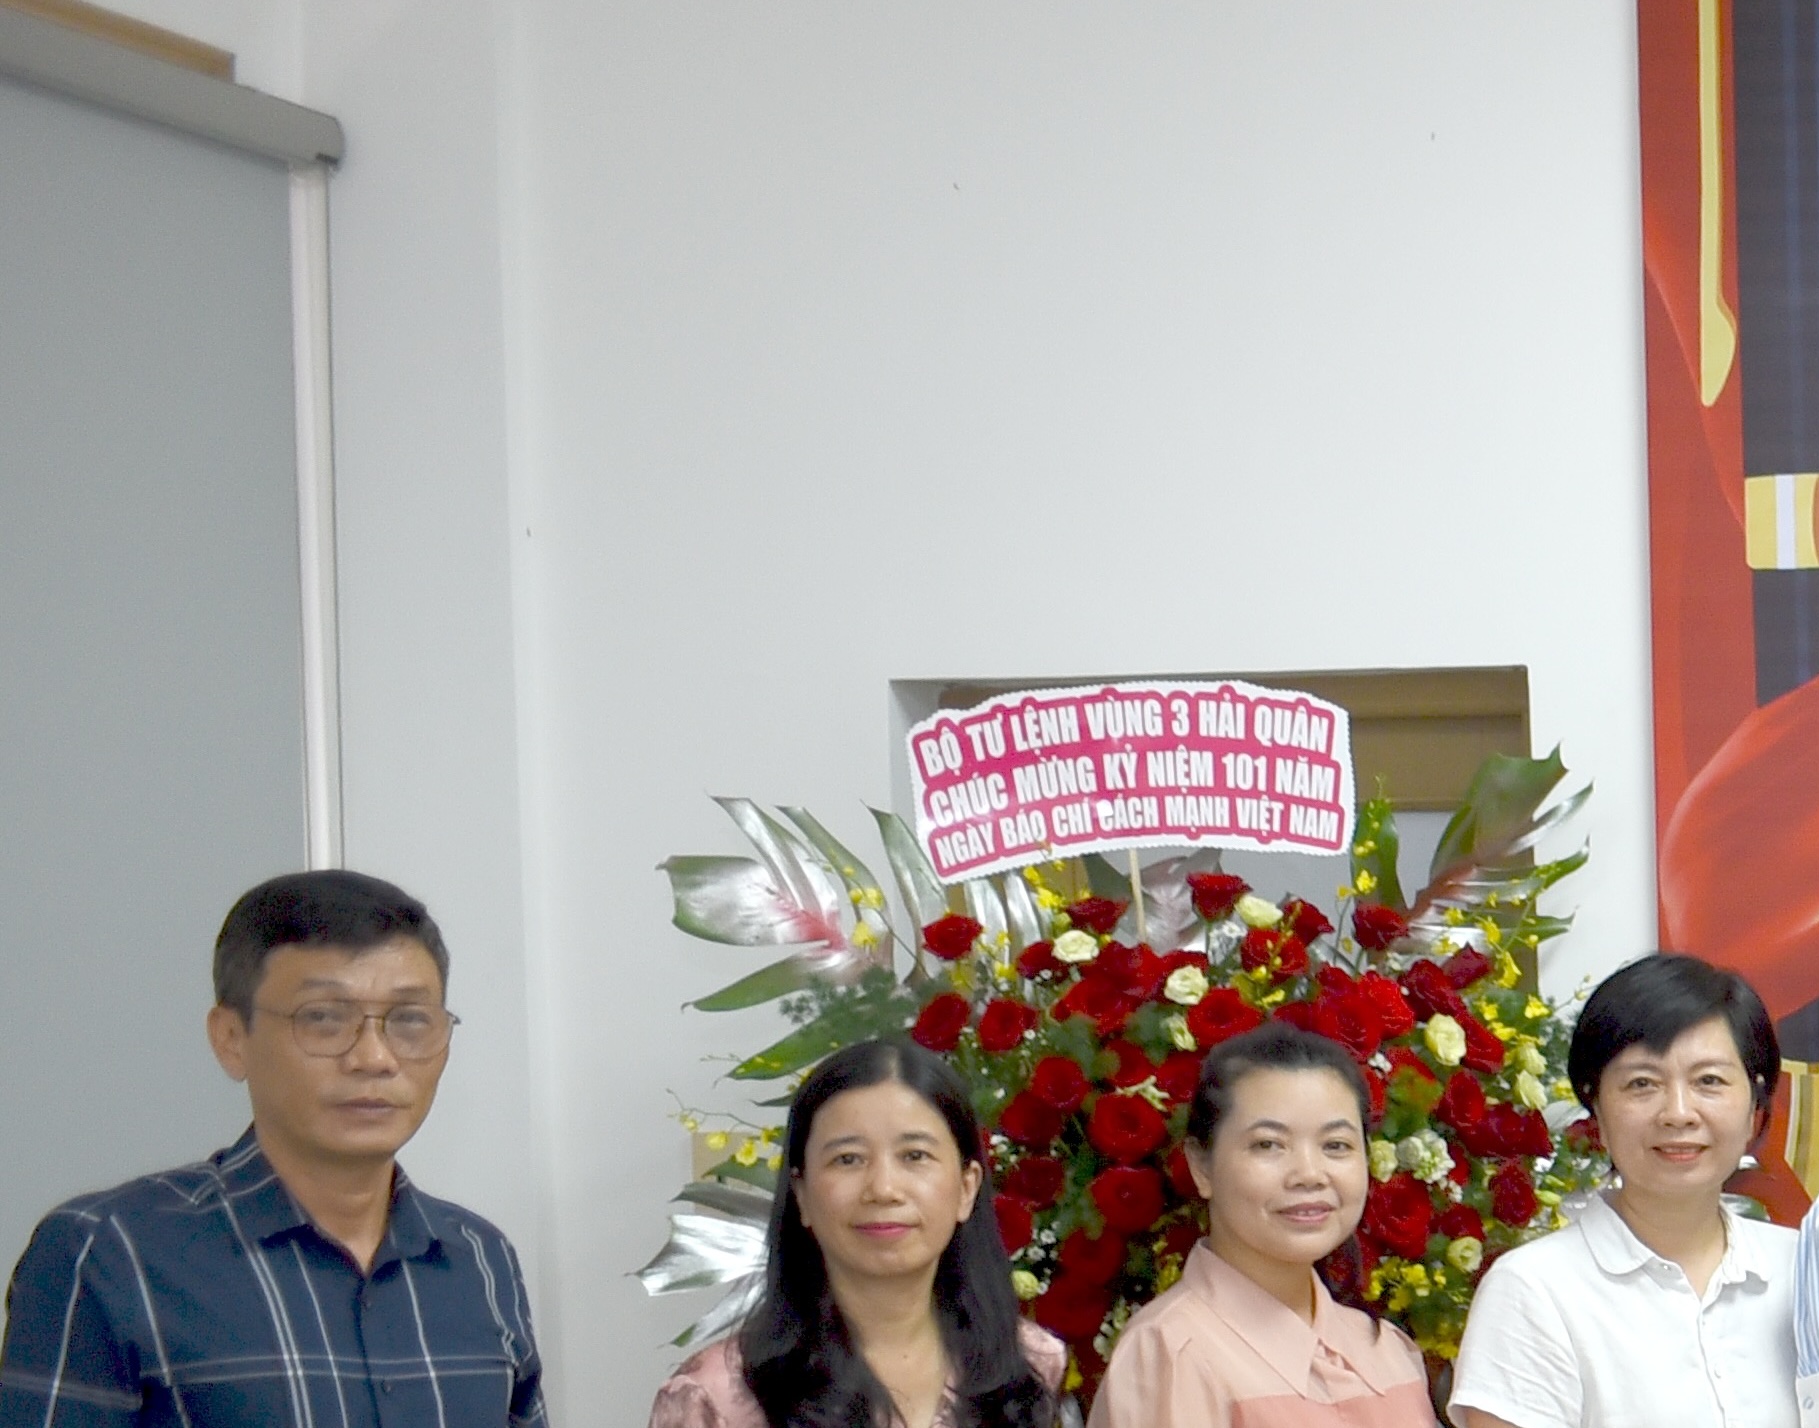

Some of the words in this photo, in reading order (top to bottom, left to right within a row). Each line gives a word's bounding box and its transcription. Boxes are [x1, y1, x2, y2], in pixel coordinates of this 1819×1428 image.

[919, 726, 963, 778] BỘ
[965, 713, 1006, 761] TƯ
[1010, 704, 1081, 755] LỆNH
[1084, 695, 1164, 741] VÙNG
[1170, 699, 1190, 738] 3
[1198, 692, 1245, 740] HẢI
[1254, 705, 1330, 753] QUÂN
[930, 772, 1009, 828] CHÚC
[1012, 755, 1097, 804] MỪNG
[1102, 743, 1138, 790] KỶ
[1146, 744, 1214, 793] NIỆM
[1221, 752, 1267, 792] 101
[1275, 754, 1335, 803] NĂM
[934, 823, 996, 870] NGÀY
[999, 808, 1047, 849] BÁO
[1051, 796, 1093, 838] CHÍ
[1096, 793, 1159, 832] CÁCH
[1236, 794, 1284, 837] VIỆT
[1289, 803, 1339, 842] NAM
